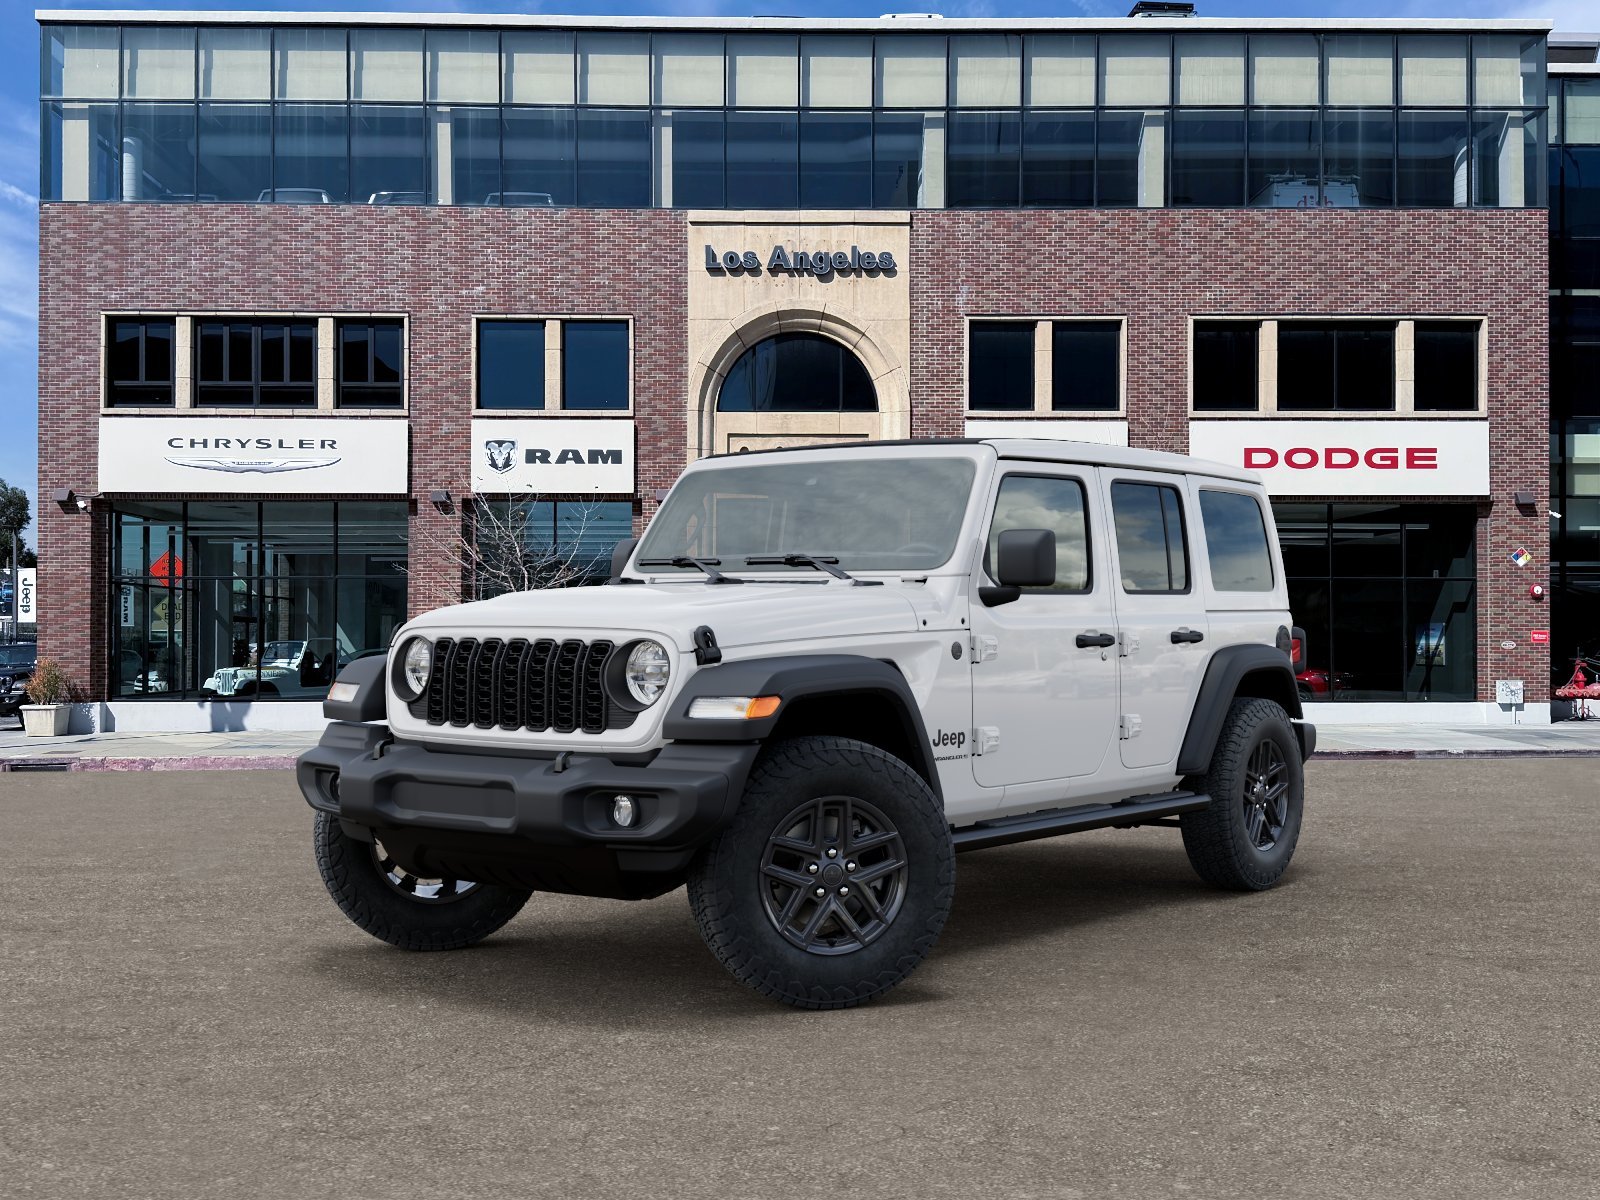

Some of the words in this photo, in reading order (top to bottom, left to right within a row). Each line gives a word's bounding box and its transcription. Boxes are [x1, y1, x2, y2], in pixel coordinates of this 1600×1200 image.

[704, 245, 759, 271] Los
[767, 245, 896, 276] Angeles
[167, 437, 338, 450] CHRYSLER
[524, 448, 623, 465] RAM
[1243, 447, 1438, 469] DODGE
[20, 577, 34, 614] Jeep
[164, 612, 181, 620] ED
[932, 728, 966, 748] Jeep
